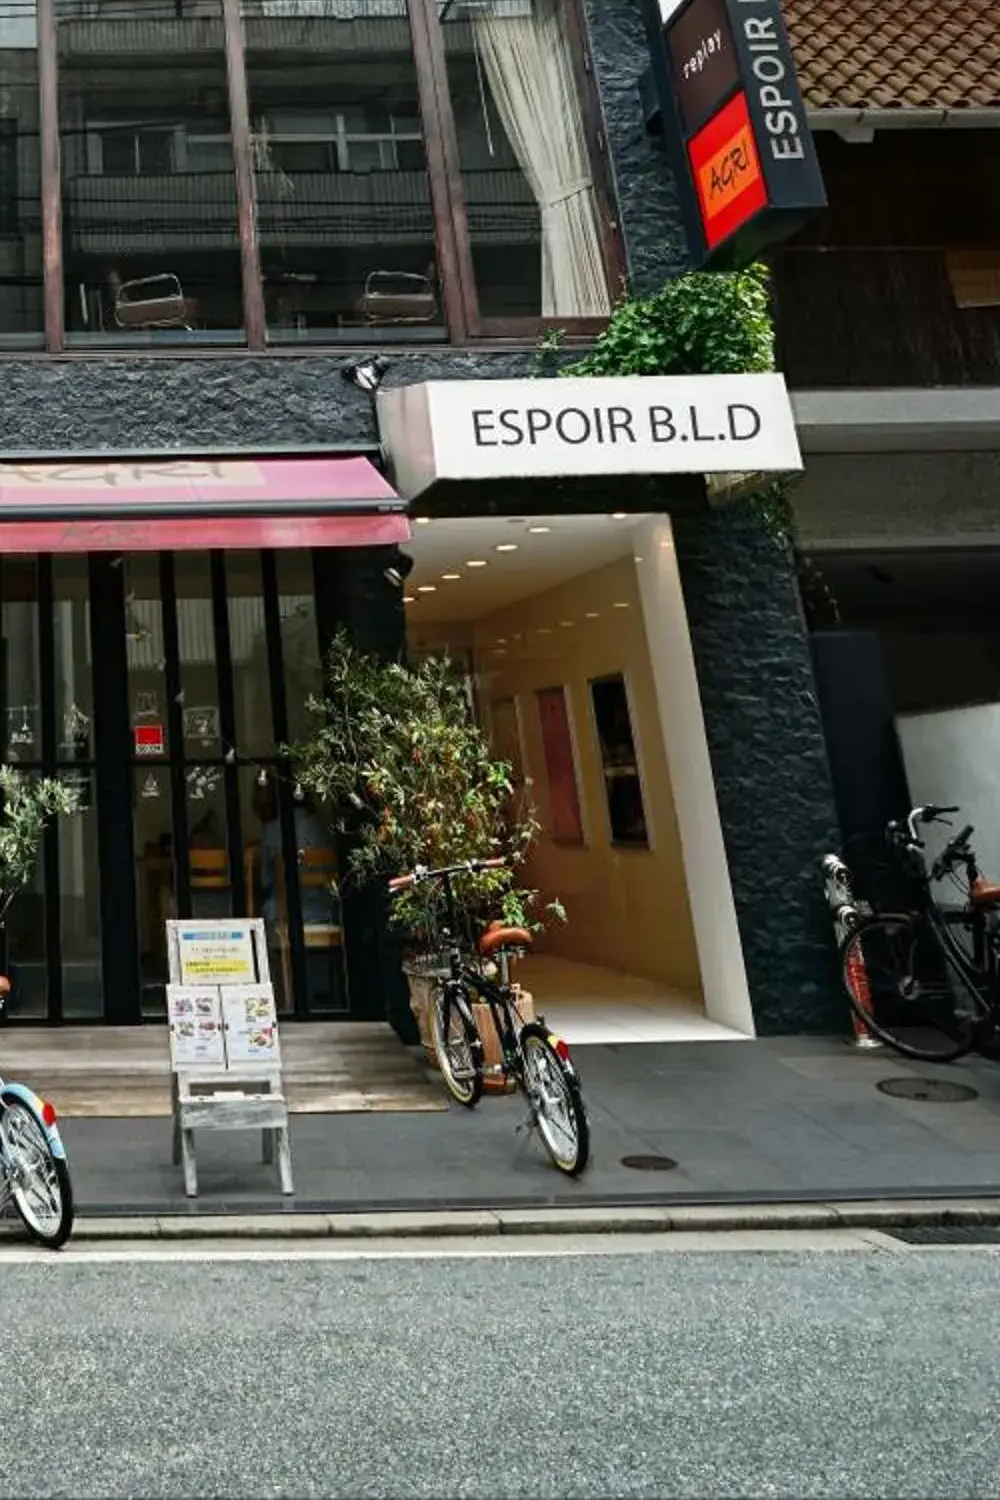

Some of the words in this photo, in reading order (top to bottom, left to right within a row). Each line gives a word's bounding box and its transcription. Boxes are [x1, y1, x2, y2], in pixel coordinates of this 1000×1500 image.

[682, 28, 722, 79] replay
[744, 17, 805, 160] ESPOIR
[709, 139, 750, 199] AGRI
[472, 406, 637, 446] ESPOIR
[648, 404, 761, 443] B.L.D
